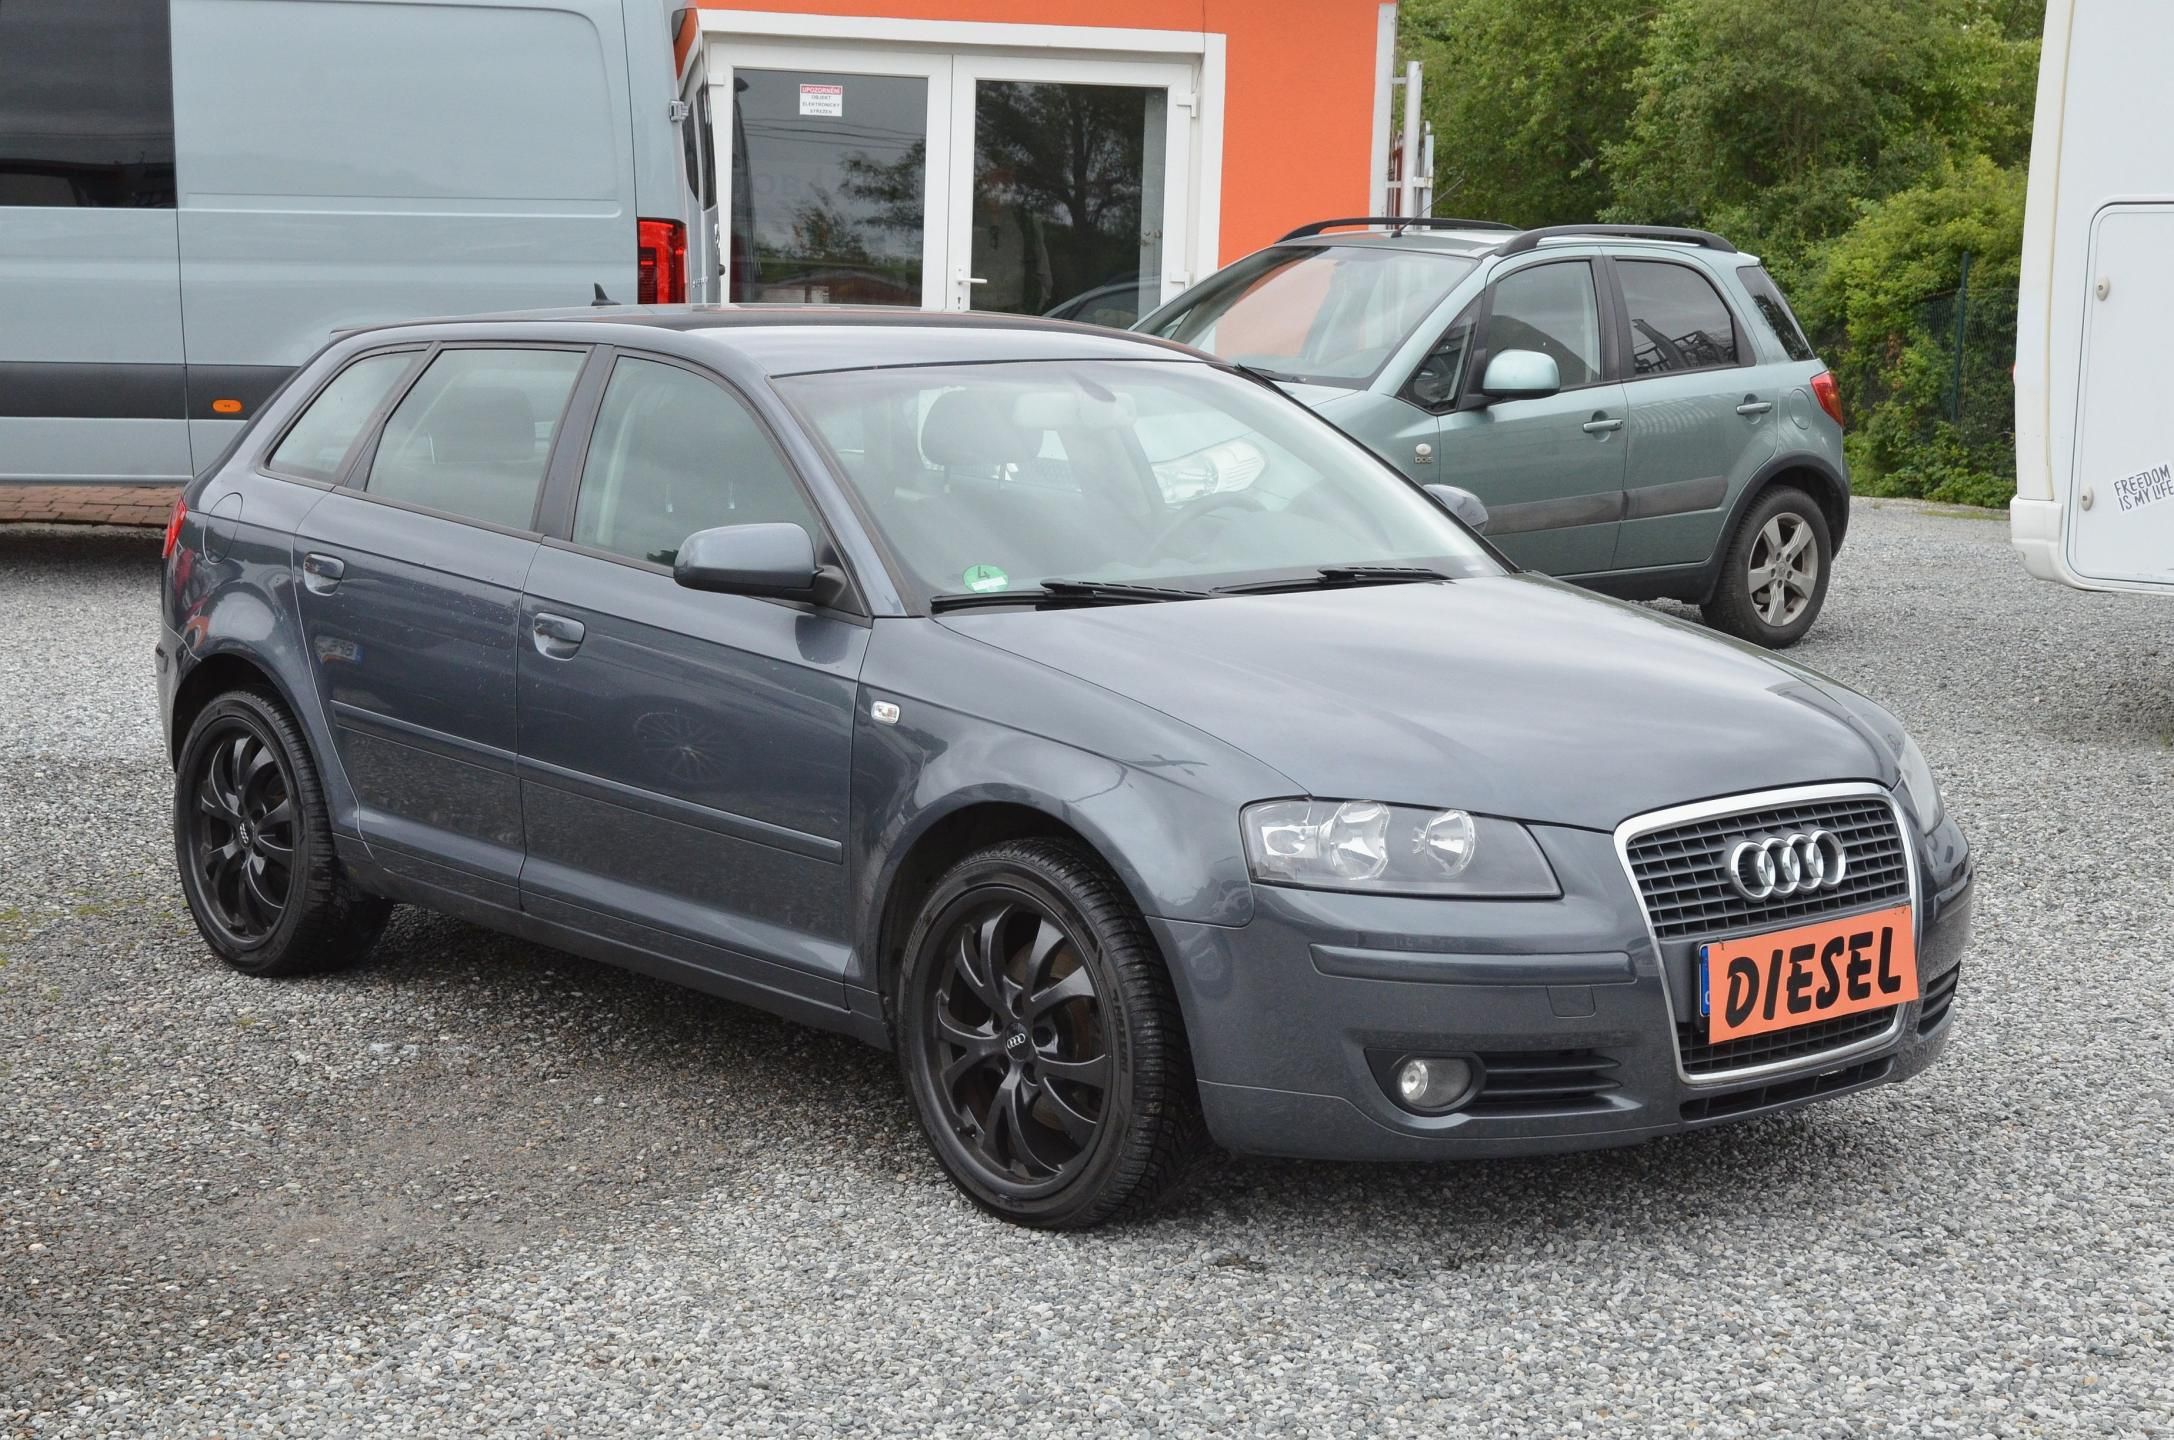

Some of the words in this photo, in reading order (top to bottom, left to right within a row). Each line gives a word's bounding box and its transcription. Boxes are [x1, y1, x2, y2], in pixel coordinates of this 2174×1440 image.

[2114, 464, 2171, 496] FREEDOM
[2118, 495, 2132, 511] IS
[2134, 488, 2151, 506] MY
[2152, 480, 2174, 500] LIFE
[1725, 927, 1902, 1028] DIESEL
